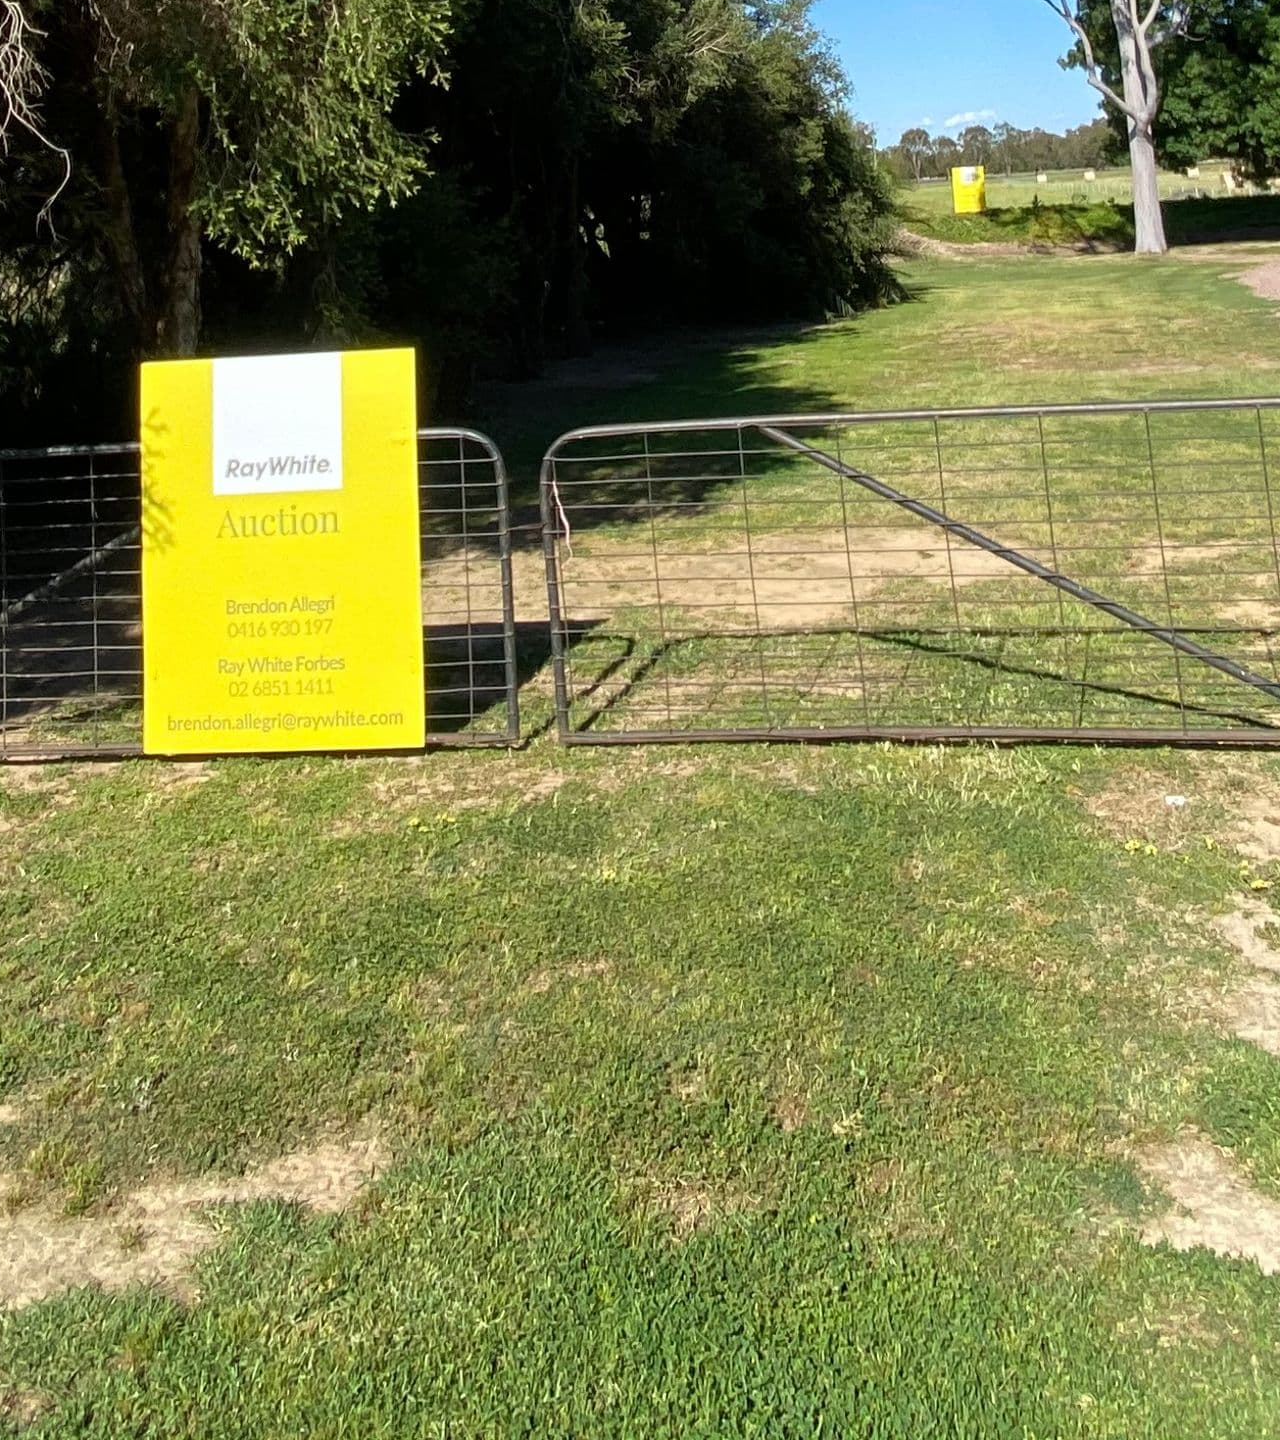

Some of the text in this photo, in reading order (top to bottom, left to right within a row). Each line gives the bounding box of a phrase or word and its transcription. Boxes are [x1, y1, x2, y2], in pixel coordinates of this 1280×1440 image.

[216, 505, 339, 538] Auction
[225, 594, 335, 615] Brendon Allegri
[227, 617, 333, 638] 0416 930 197
[218, 653, 345, 677] Ray White Forbes
[228, 677, 335, 697] 02 6851 1411
[167, 711, 404, 732] brendon.allegri@raywhite.com
